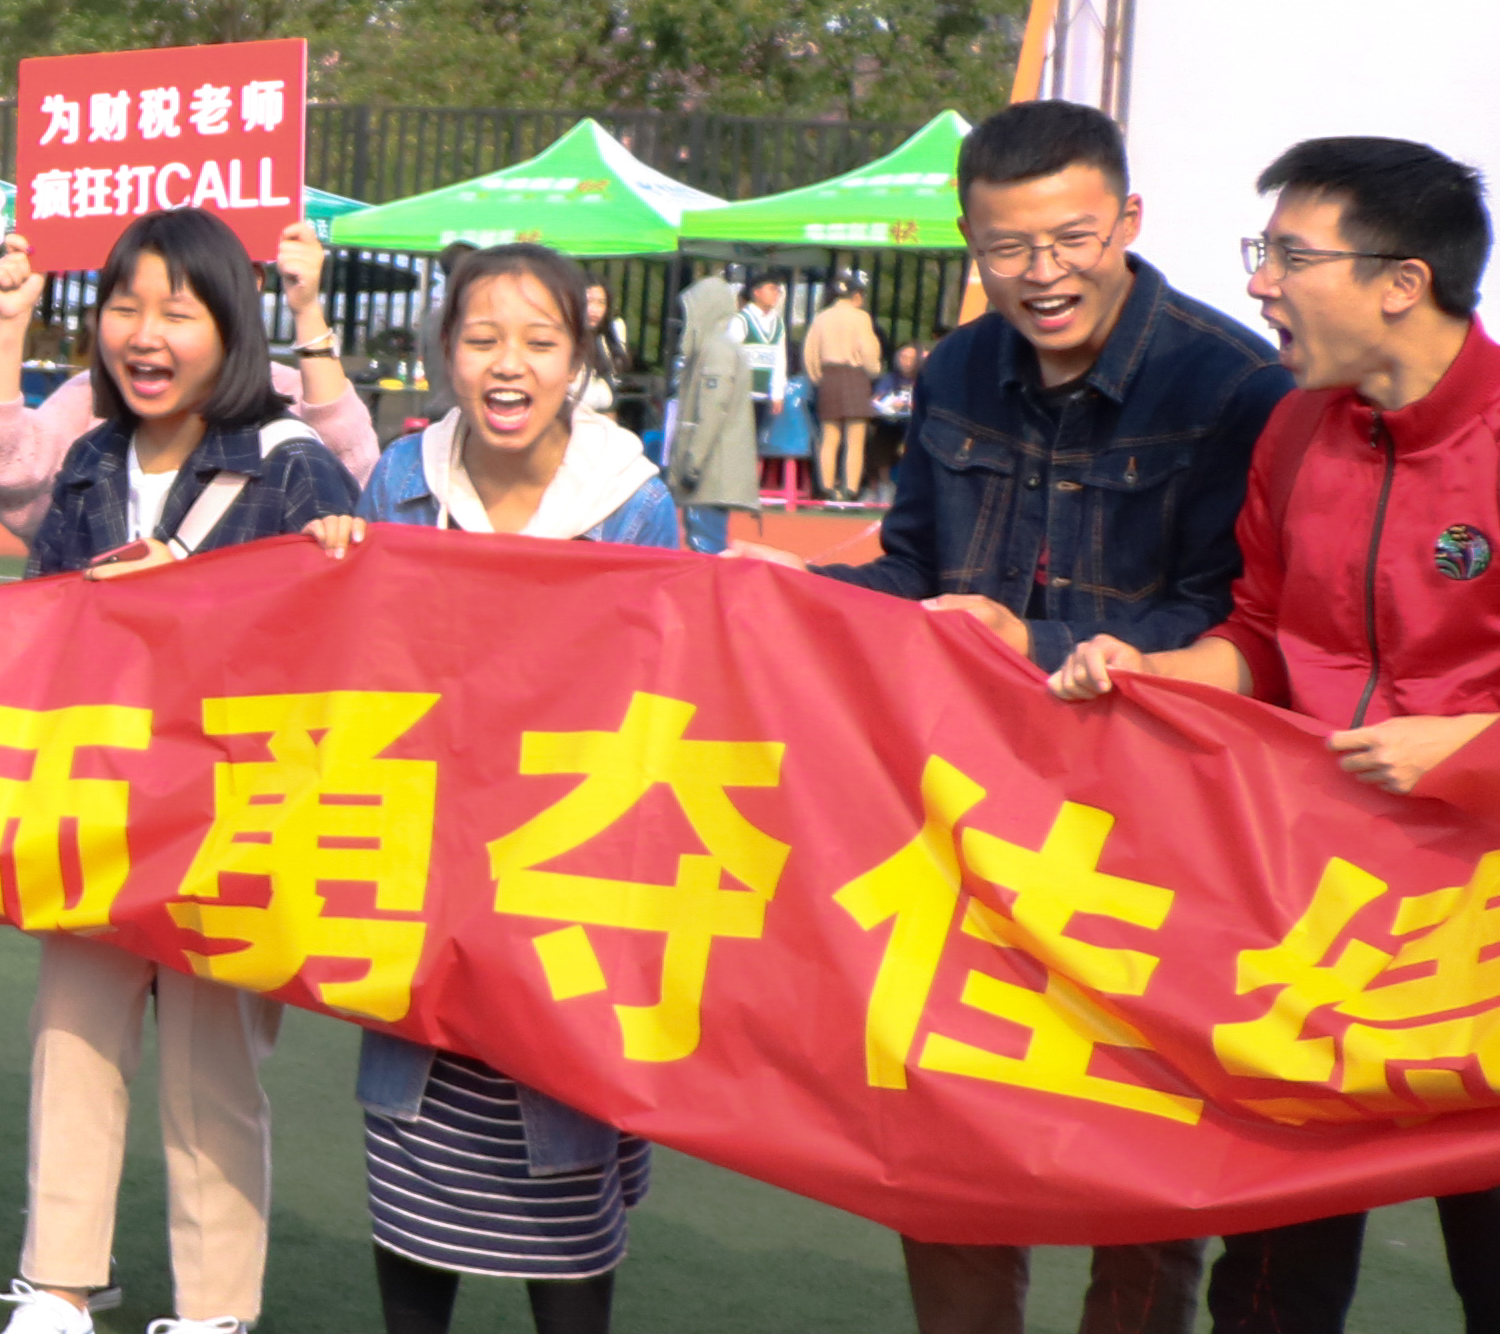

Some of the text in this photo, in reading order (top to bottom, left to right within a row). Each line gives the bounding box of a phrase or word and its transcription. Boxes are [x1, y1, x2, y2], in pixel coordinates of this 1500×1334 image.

[39, 80, 285, 146] 为财税老师
[30, 156, 291, 220] 疯狂打CALL
